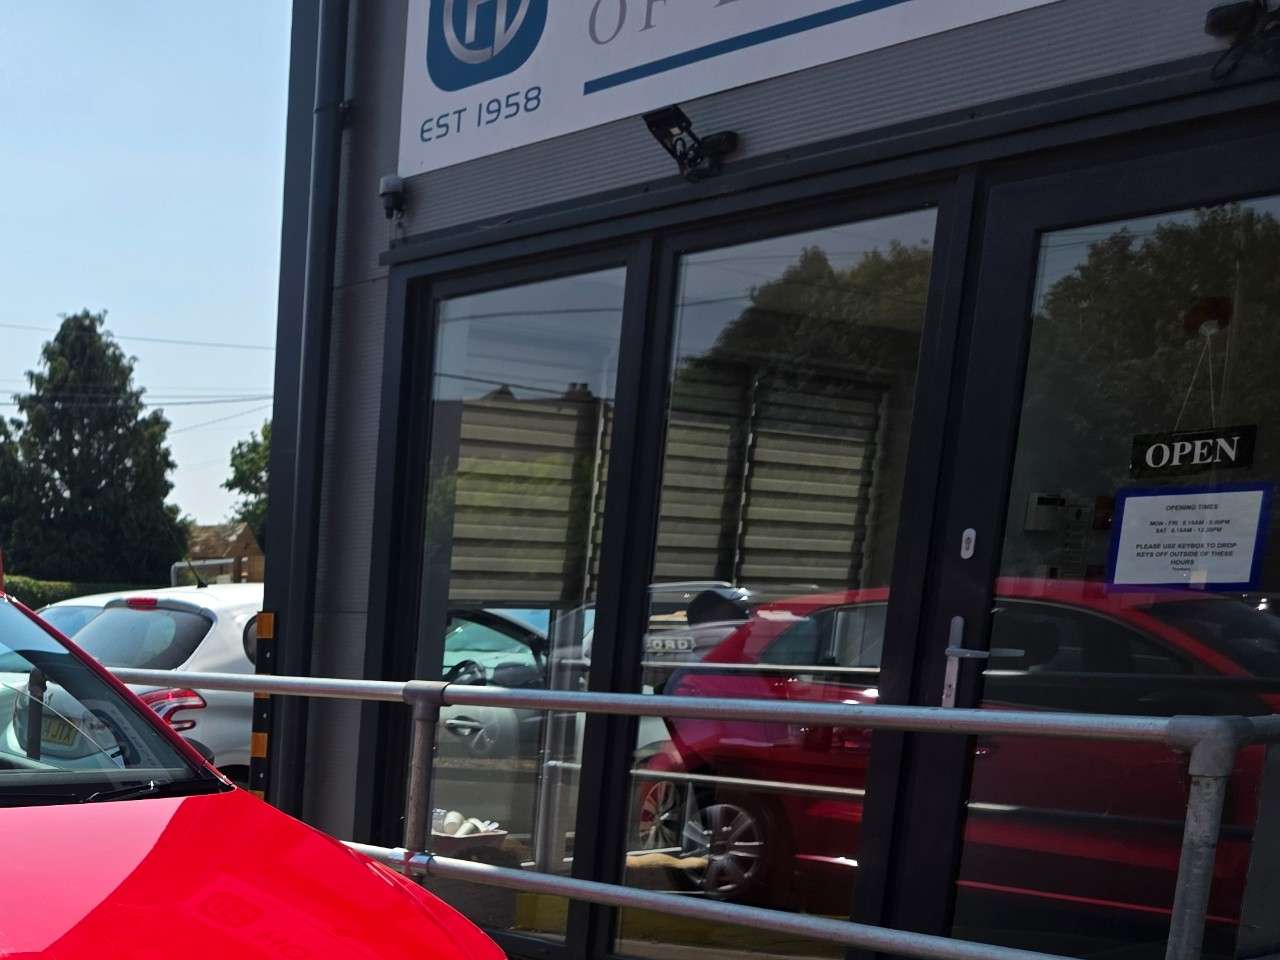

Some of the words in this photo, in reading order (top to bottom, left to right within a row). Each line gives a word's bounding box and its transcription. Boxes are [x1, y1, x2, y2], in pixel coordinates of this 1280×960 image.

[420, 107, 467, 142] EST
[477, 86, 542, 128] 1958
[1145, 436, 1241, 468] OPEN
